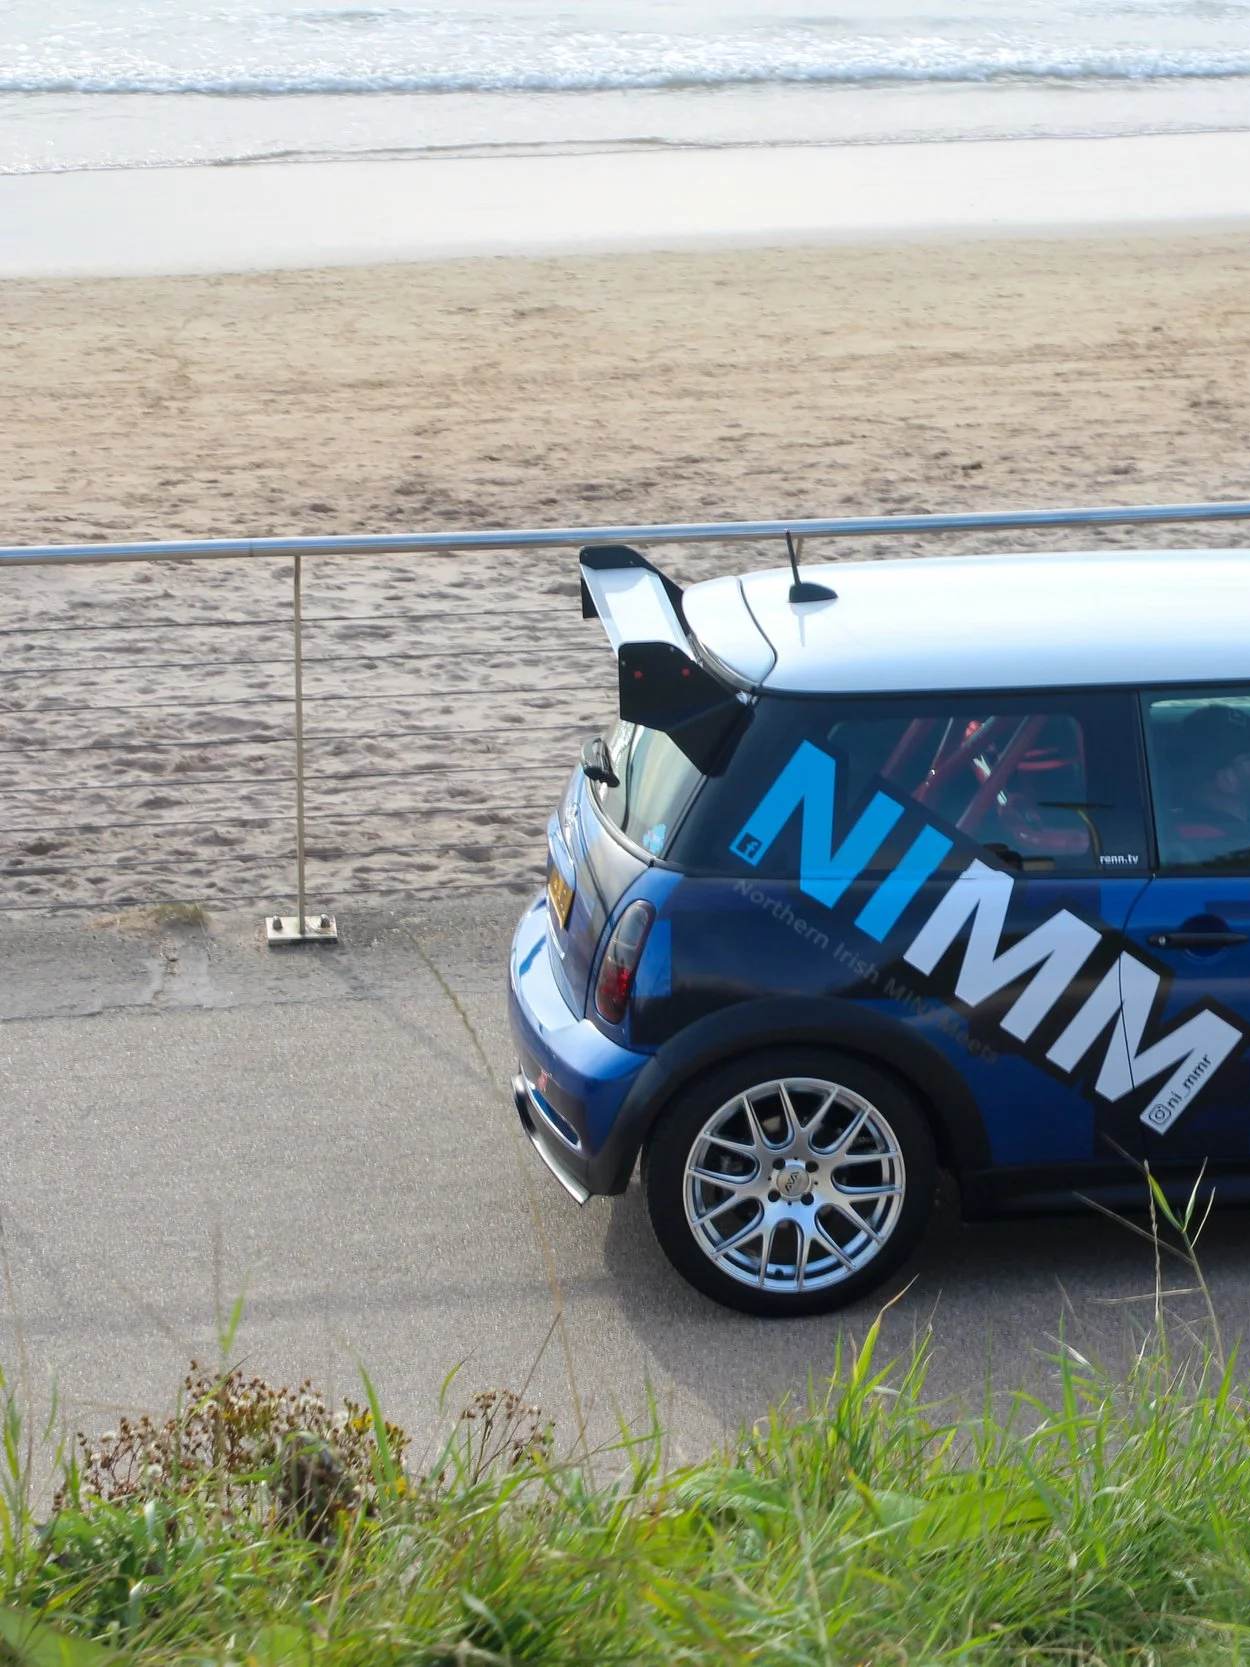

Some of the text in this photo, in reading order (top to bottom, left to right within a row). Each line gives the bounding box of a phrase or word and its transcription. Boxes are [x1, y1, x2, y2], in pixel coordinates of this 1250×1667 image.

[1099, 853, 1139, 865] renn.tv
[732, 879, 830, 952] Northern
[833, 940, 880, 984] Irish
[883, 976, 935, 1019] MIN
[1167, 1053, 1211, 1110] ni_mmr
